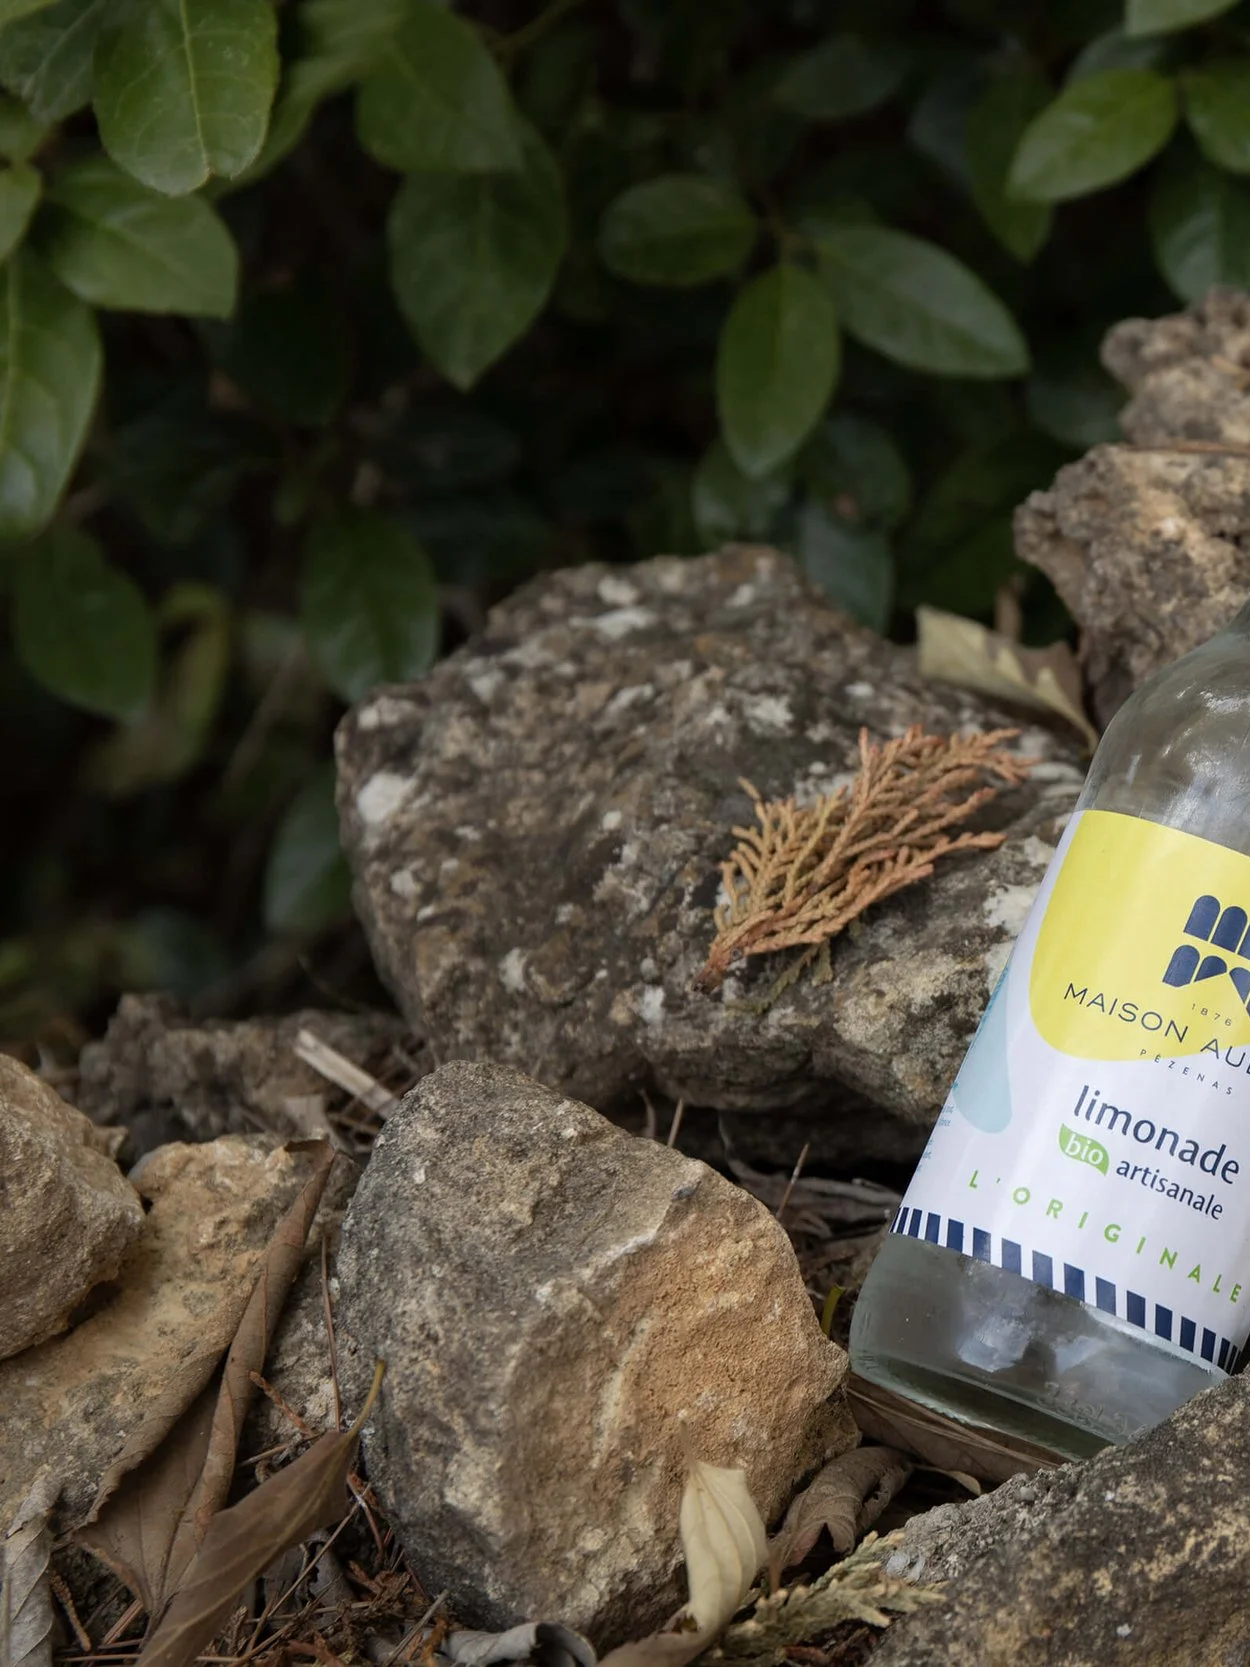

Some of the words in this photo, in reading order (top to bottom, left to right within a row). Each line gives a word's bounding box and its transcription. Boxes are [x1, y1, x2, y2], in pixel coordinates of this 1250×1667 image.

[1063, 983, 1188, 1043] MAISON
[1191, 1003, 1232, 1026] 1876
[1065, 1134, 1104, 1165] bio
[1116, 1160, 1223, 1220] artisanale
[1074, 1085, 1240, 1184] limonade
[969, 1169, 1242, 1303] L'ORIGINALE
